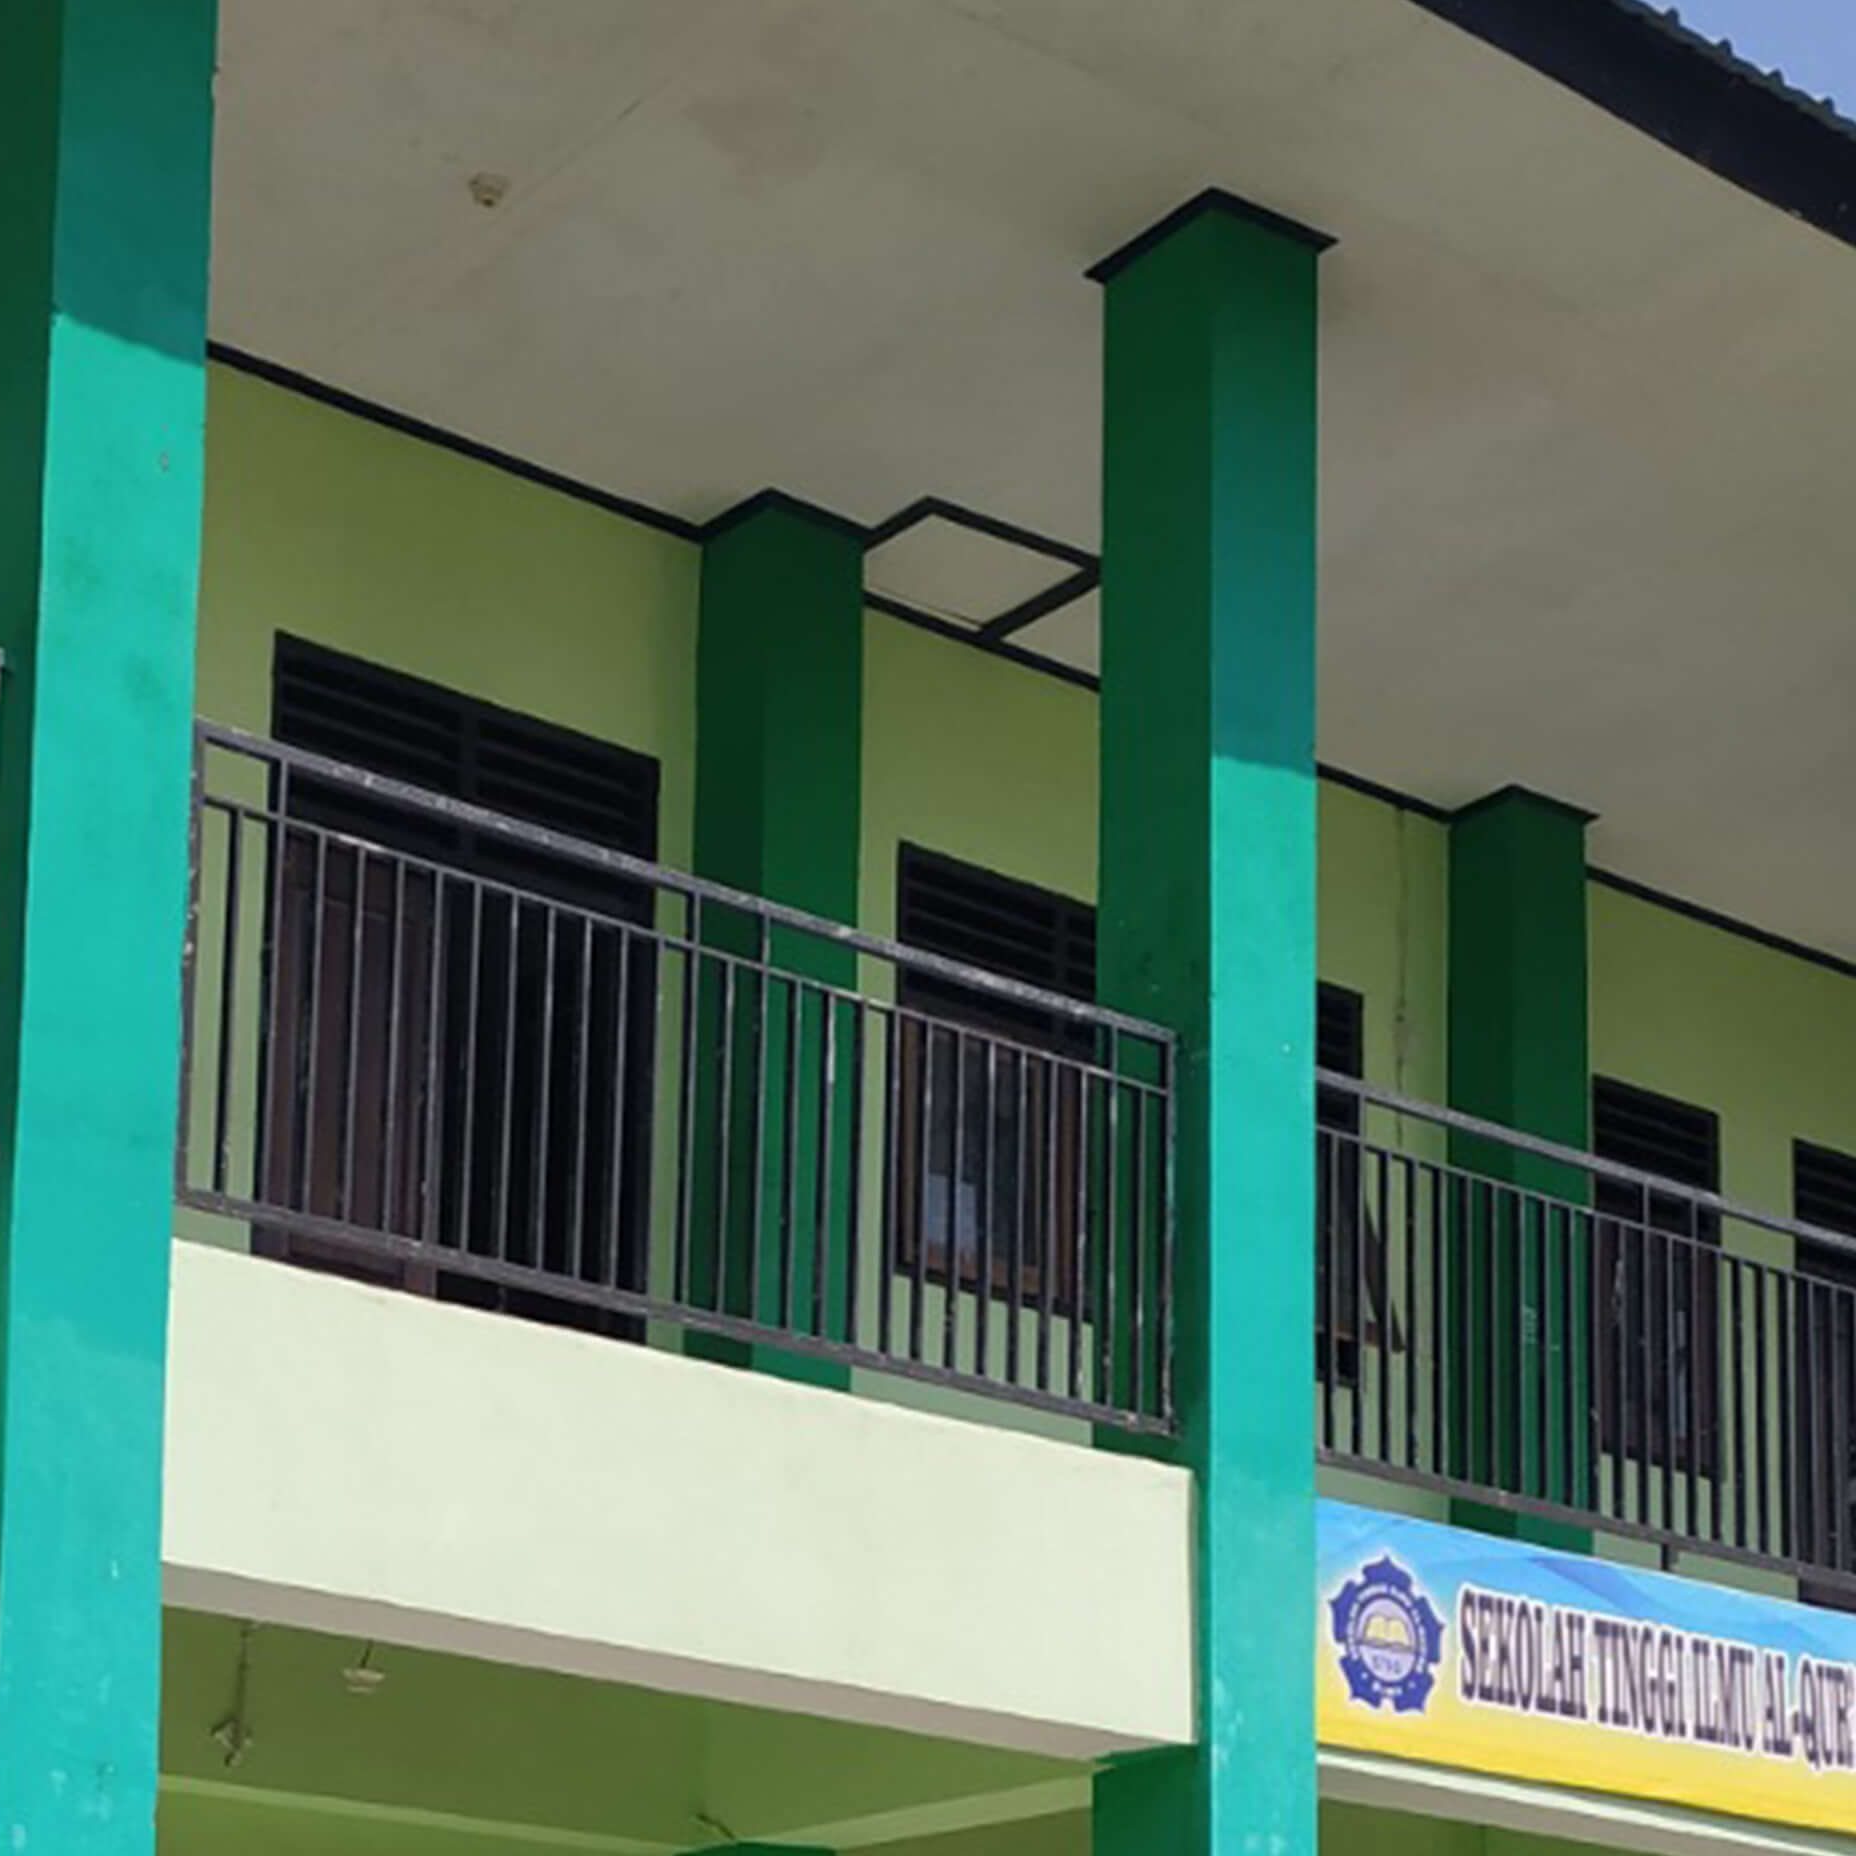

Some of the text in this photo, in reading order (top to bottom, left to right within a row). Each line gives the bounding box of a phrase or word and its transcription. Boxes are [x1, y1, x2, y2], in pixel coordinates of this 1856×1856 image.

[1460, 1586, 1588, 1721] SEKOLAH
[1593, 1618, 1686, 1739] TINGGI
[1691, 1638, 1754, 1751] ILMU
